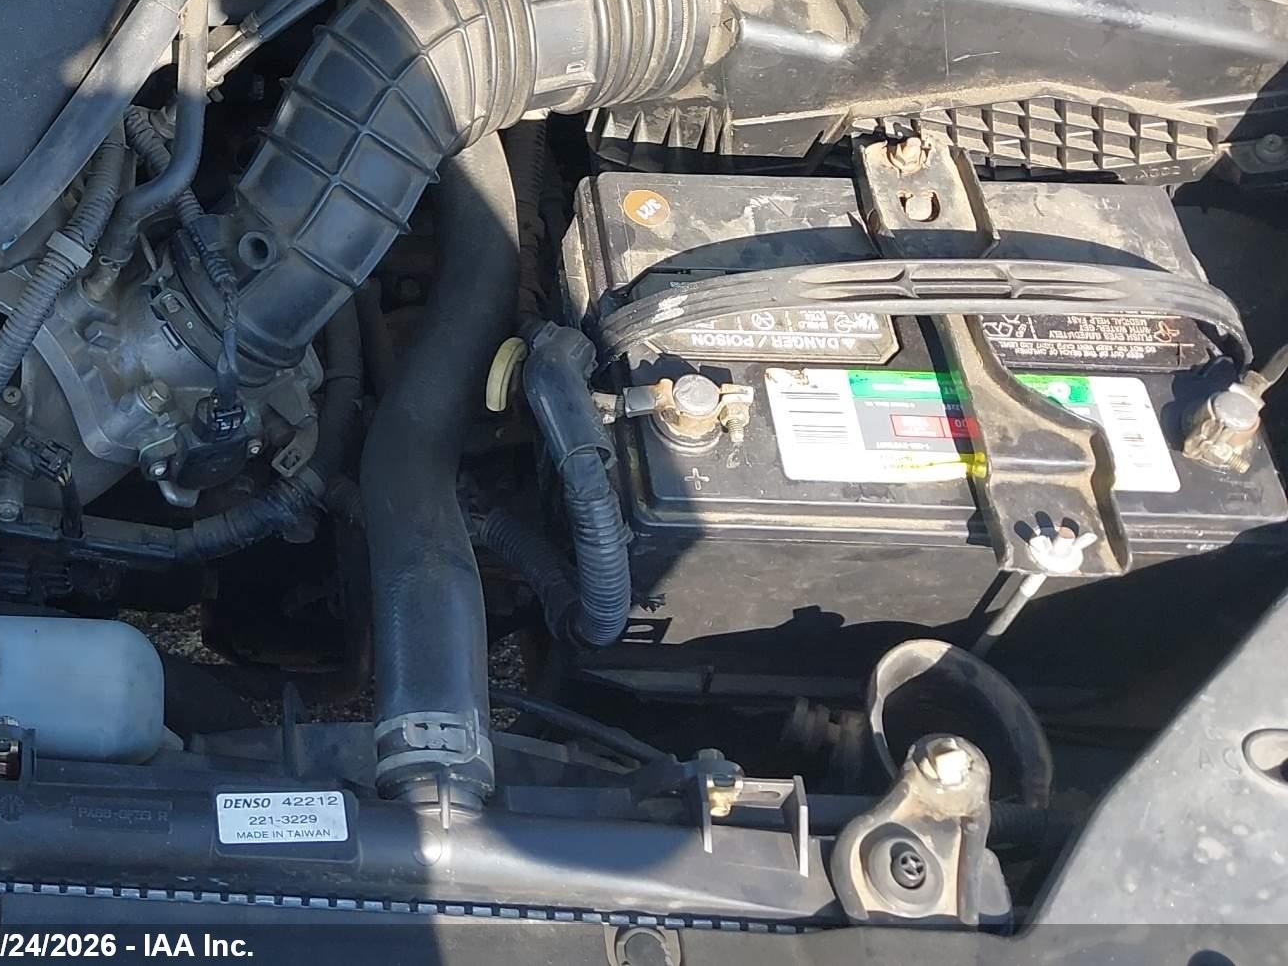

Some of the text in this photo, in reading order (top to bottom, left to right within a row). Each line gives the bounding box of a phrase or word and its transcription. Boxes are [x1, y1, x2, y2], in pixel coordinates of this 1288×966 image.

[1067, 316, 1148, 326] MEDICAL HELP FAST
[692, 334, 753, 348] POISON
[772, 335, 840, 349] DANGER
[1049, 330, 1153, 342] FLUSH EYES IMMEDIATELY
[223, 795, 339, 809] DENSO 42212
[248, 814, 318, 826] 221-3229
[236, 828, 331, 839] MADE IN TAIWAN
